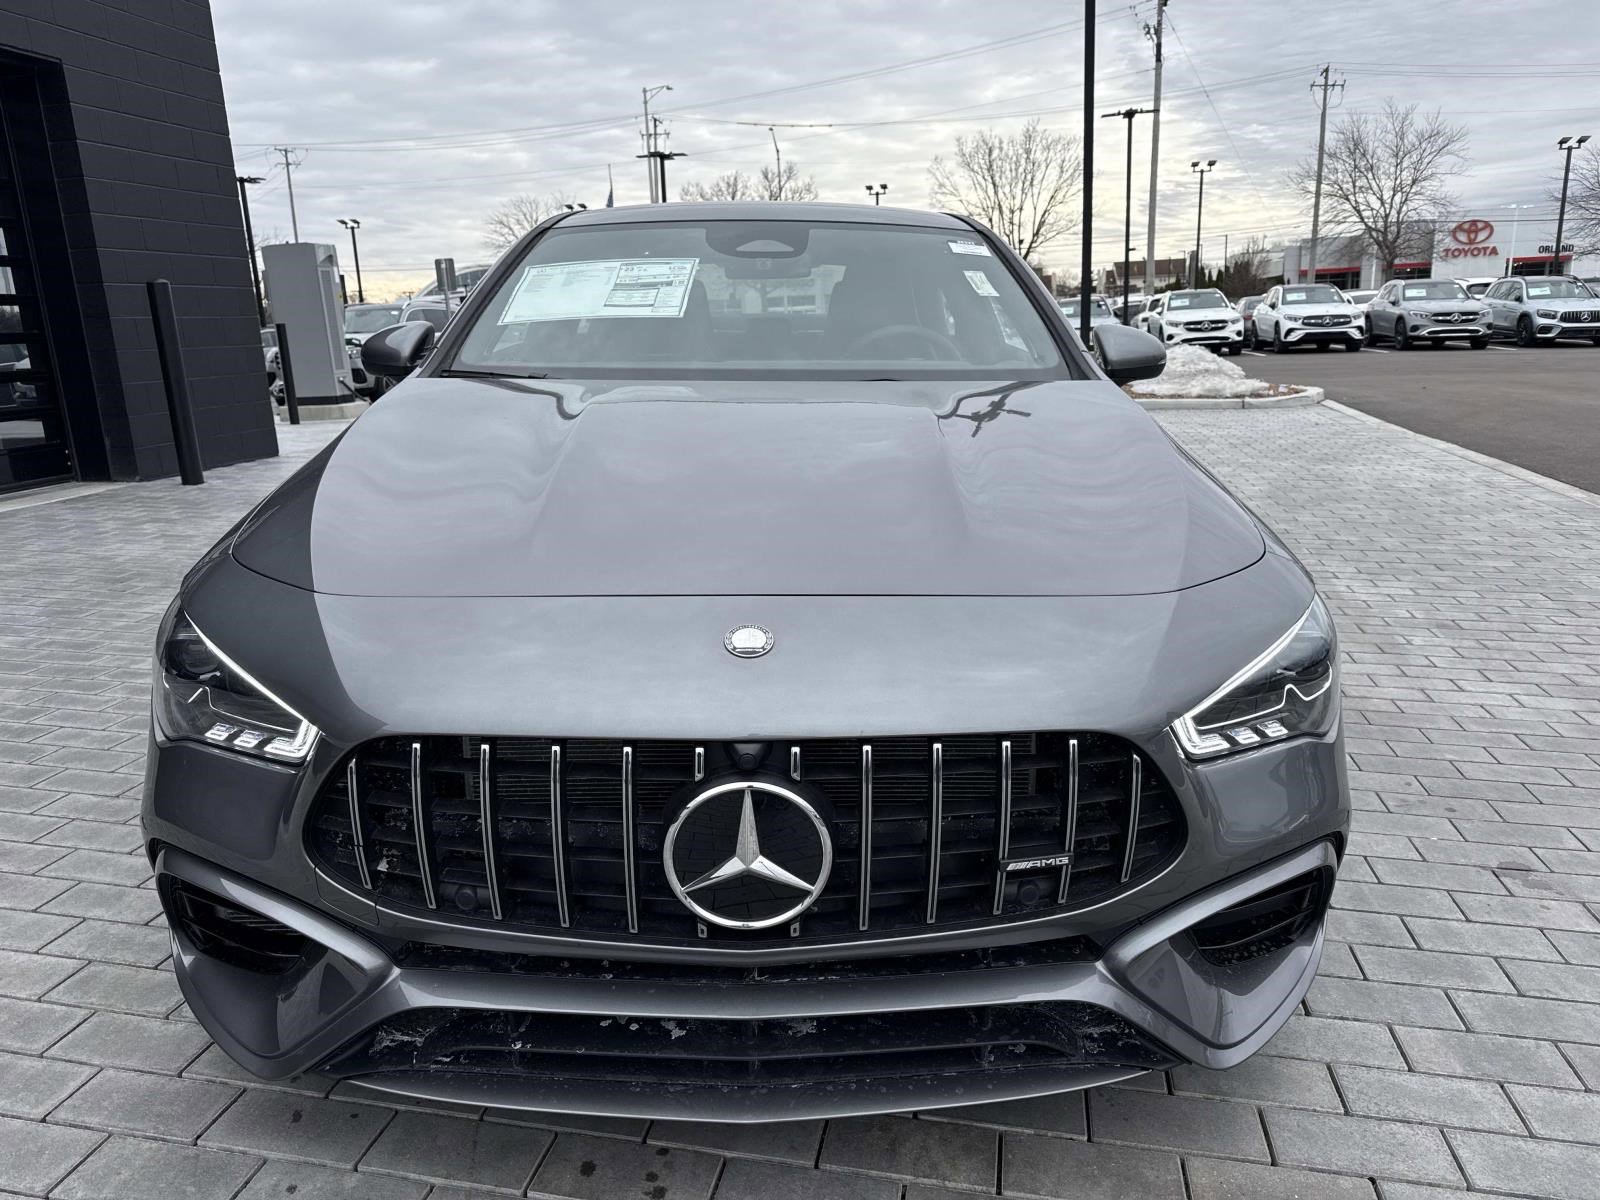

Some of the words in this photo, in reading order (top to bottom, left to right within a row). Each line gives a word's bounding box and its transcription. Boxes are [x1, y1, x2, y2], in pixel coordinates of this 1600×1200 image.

[1442, 246, 1499, 257] TOYOTA
[1538, 244, 1574, 254] ORLND
[1027, 857, 1068, 868] AMG
